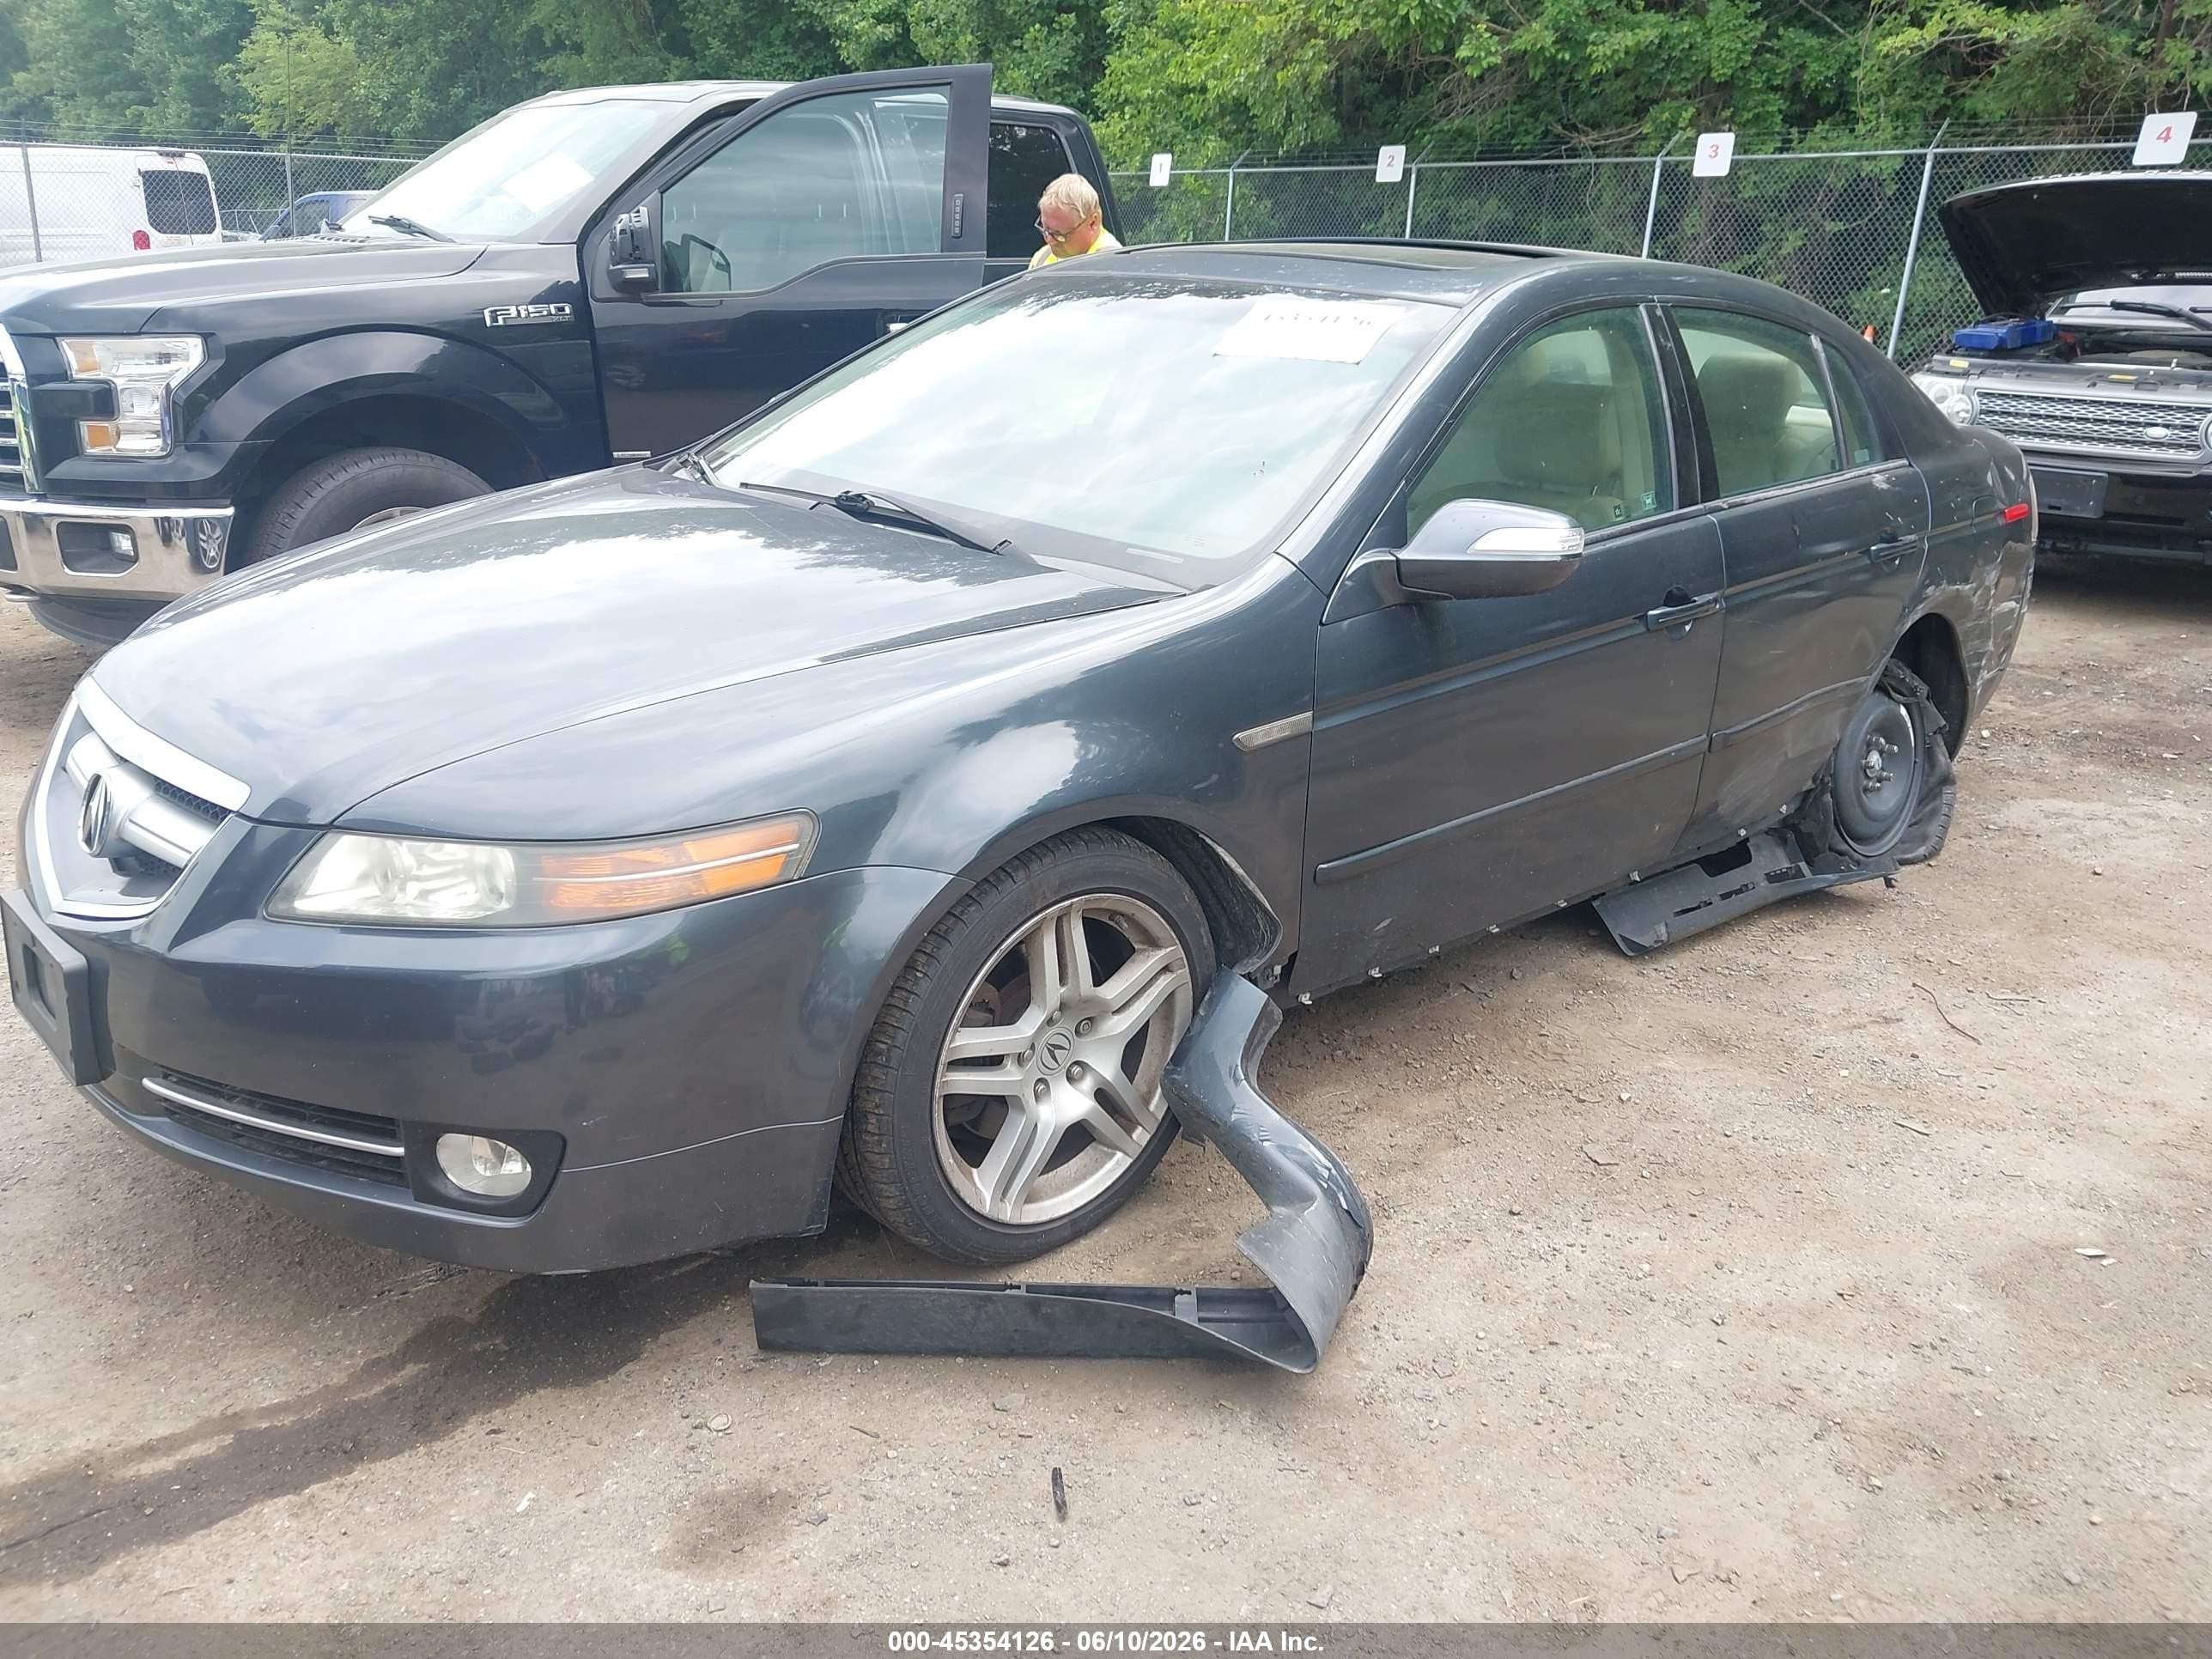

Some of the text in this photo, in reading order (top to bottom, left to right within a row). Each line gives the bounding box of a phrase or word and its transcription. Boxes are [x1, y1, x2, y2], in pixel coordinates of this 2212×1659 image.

[2155, 125, 2173, 143] 4
[1709, 144, 1718, 158] 3
[1387, 155, 1395, 167] 2
